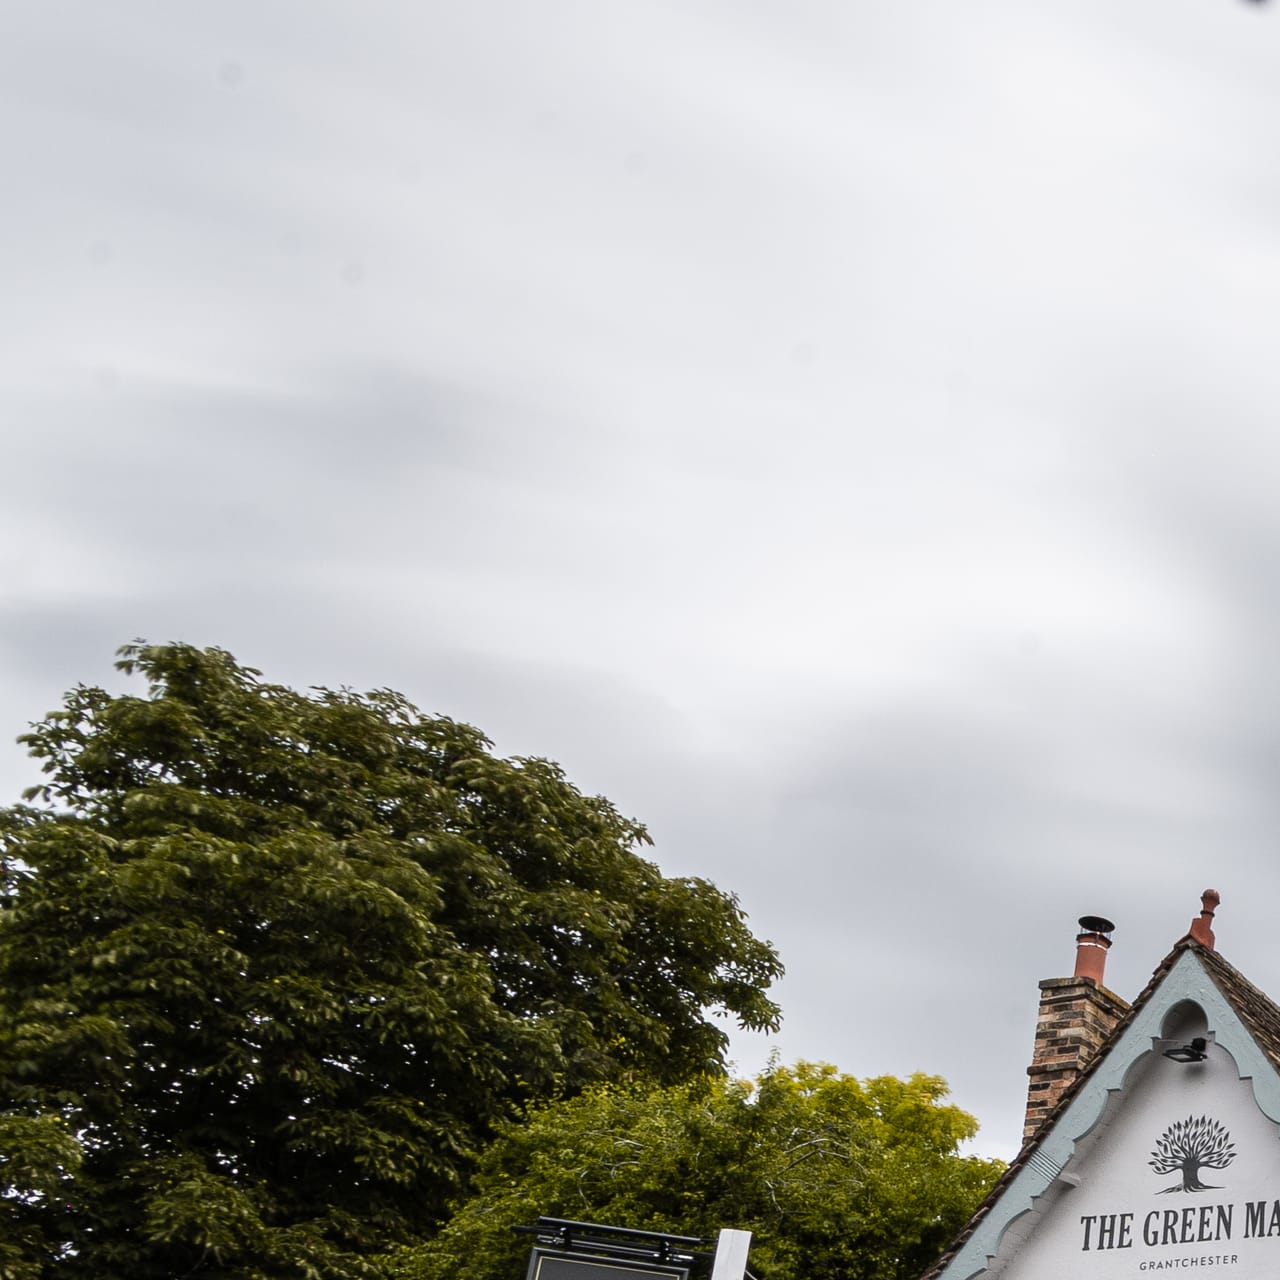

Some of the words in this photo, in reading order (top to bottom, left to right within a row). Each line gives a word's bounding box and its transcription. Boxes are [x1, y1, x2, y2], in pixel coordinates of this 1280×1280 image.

[1080, 1213, 1134, 1251] THE
[1143, 1204, 1234, 1247] GREEN
[1139, 1254, 1238, 1271] GRANTCHESTER
